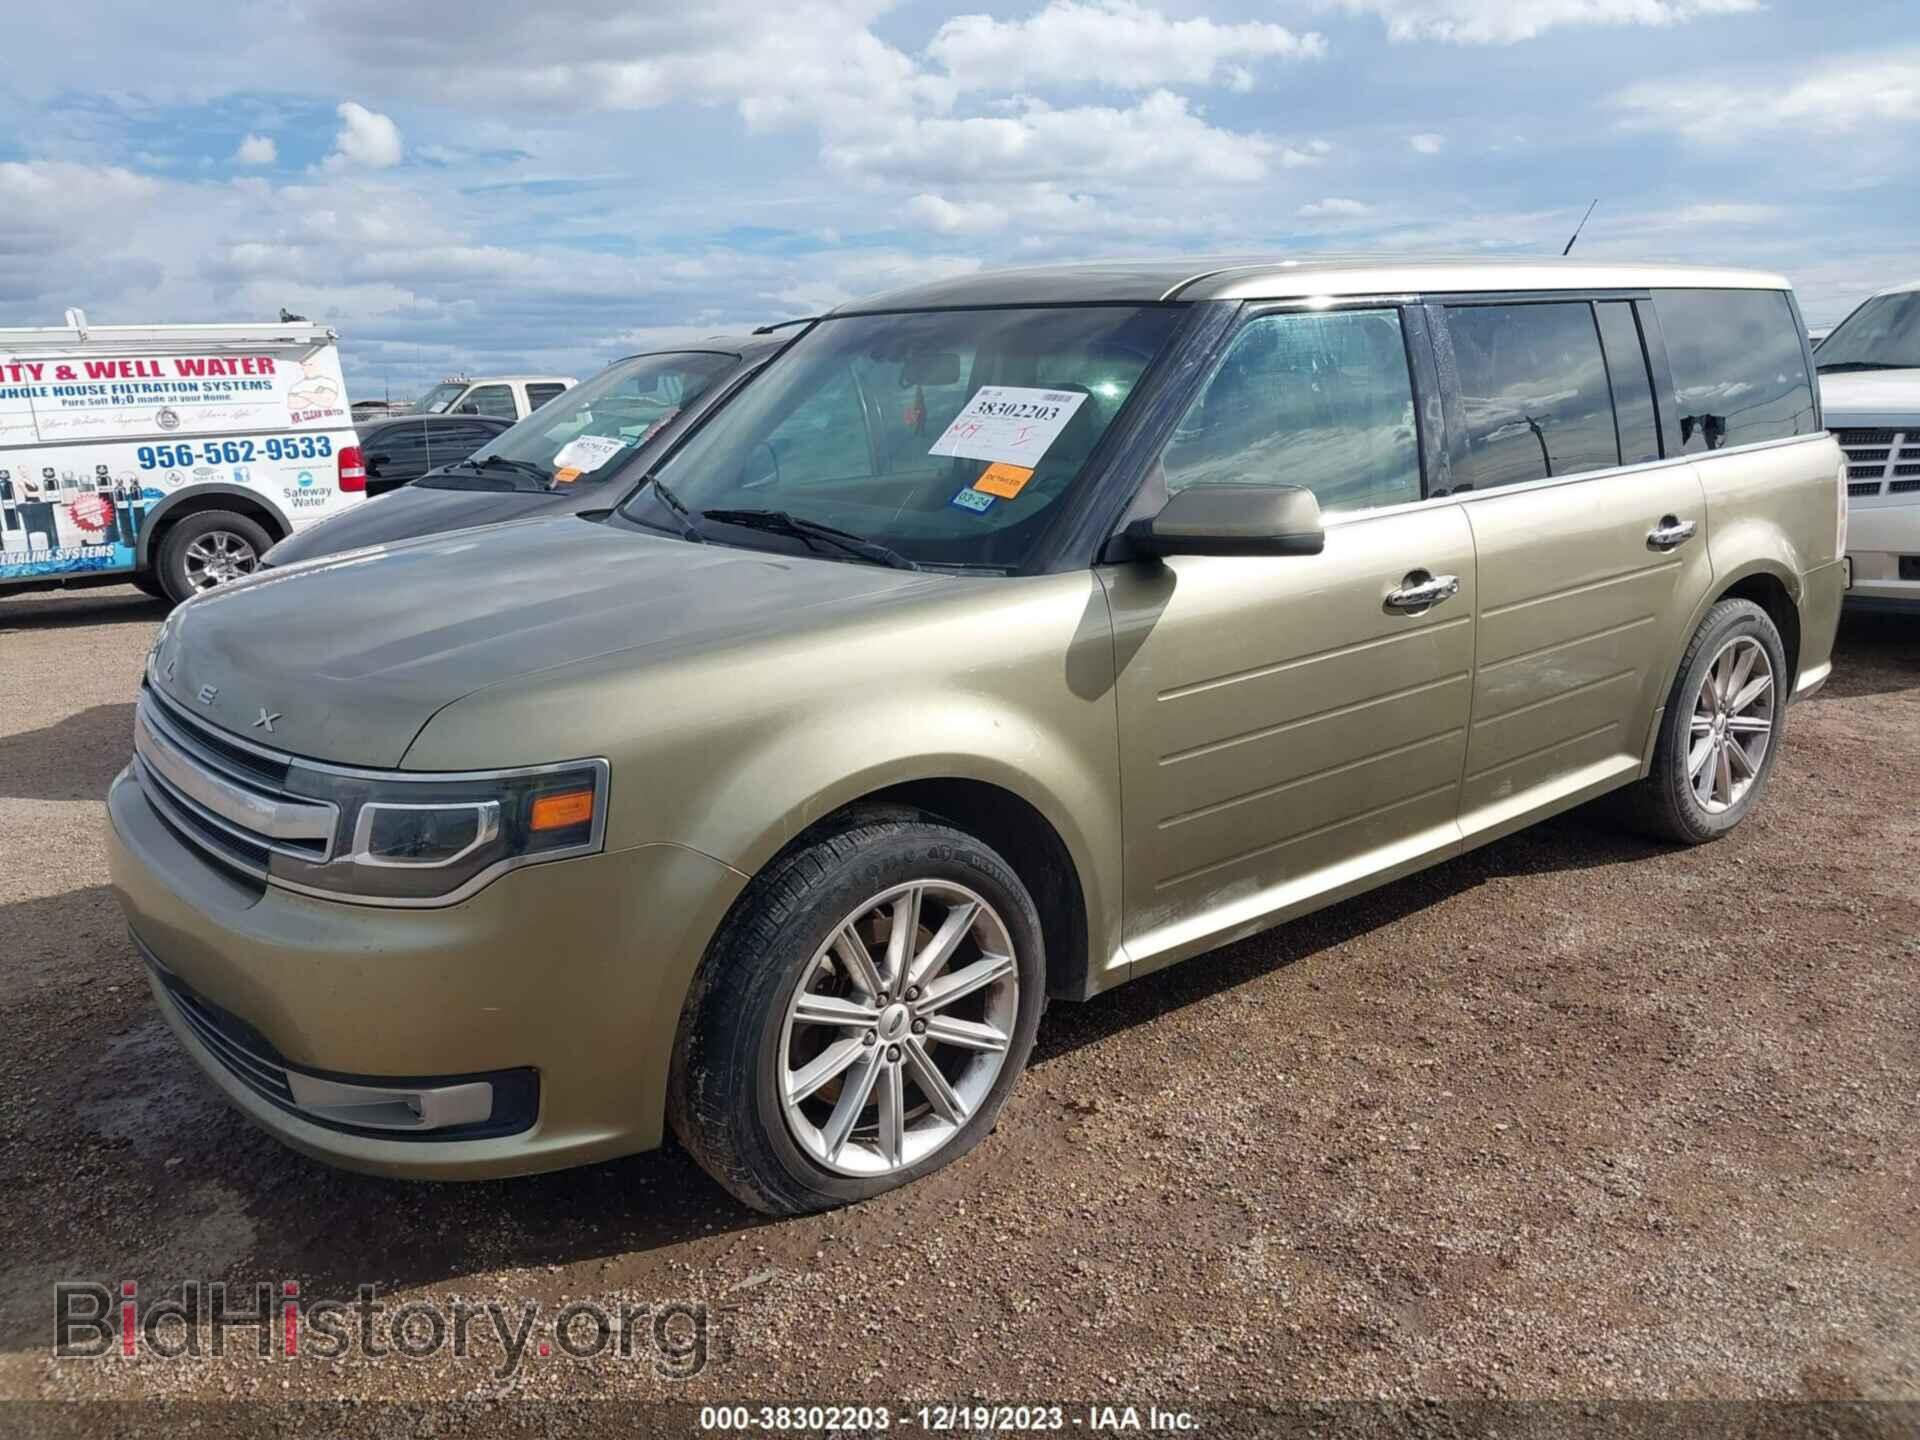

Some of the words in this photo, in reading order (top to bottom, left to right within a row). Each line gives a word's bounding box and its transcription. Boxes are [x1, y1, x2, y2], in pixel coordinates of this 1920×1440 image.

[55, 365, 78, 380] &
[84, 360, 166, 379] WELL
[174, 357, 276, 377] WATER
[52, 384, 107, 397] HOUSE
[111, 382, 199, 395] FILTRATION
[202, 380, 273, 392] SYSTEMS
[62, 399, 86, 407] Pure
[88, 398, 108, 406] Soft
[137, 396, 165, 404] made
[168, 394, 178, 402] at
[181, 395, 201, 403] your
[971, 401, 1060, 421] 38302203
[137, 436, 333, 470] 956-562-9533
[283, 486, 333, 499] Safeway
[290, 497, 326, 508] Water
[56, 544, 115, 561] SYSTEMS
